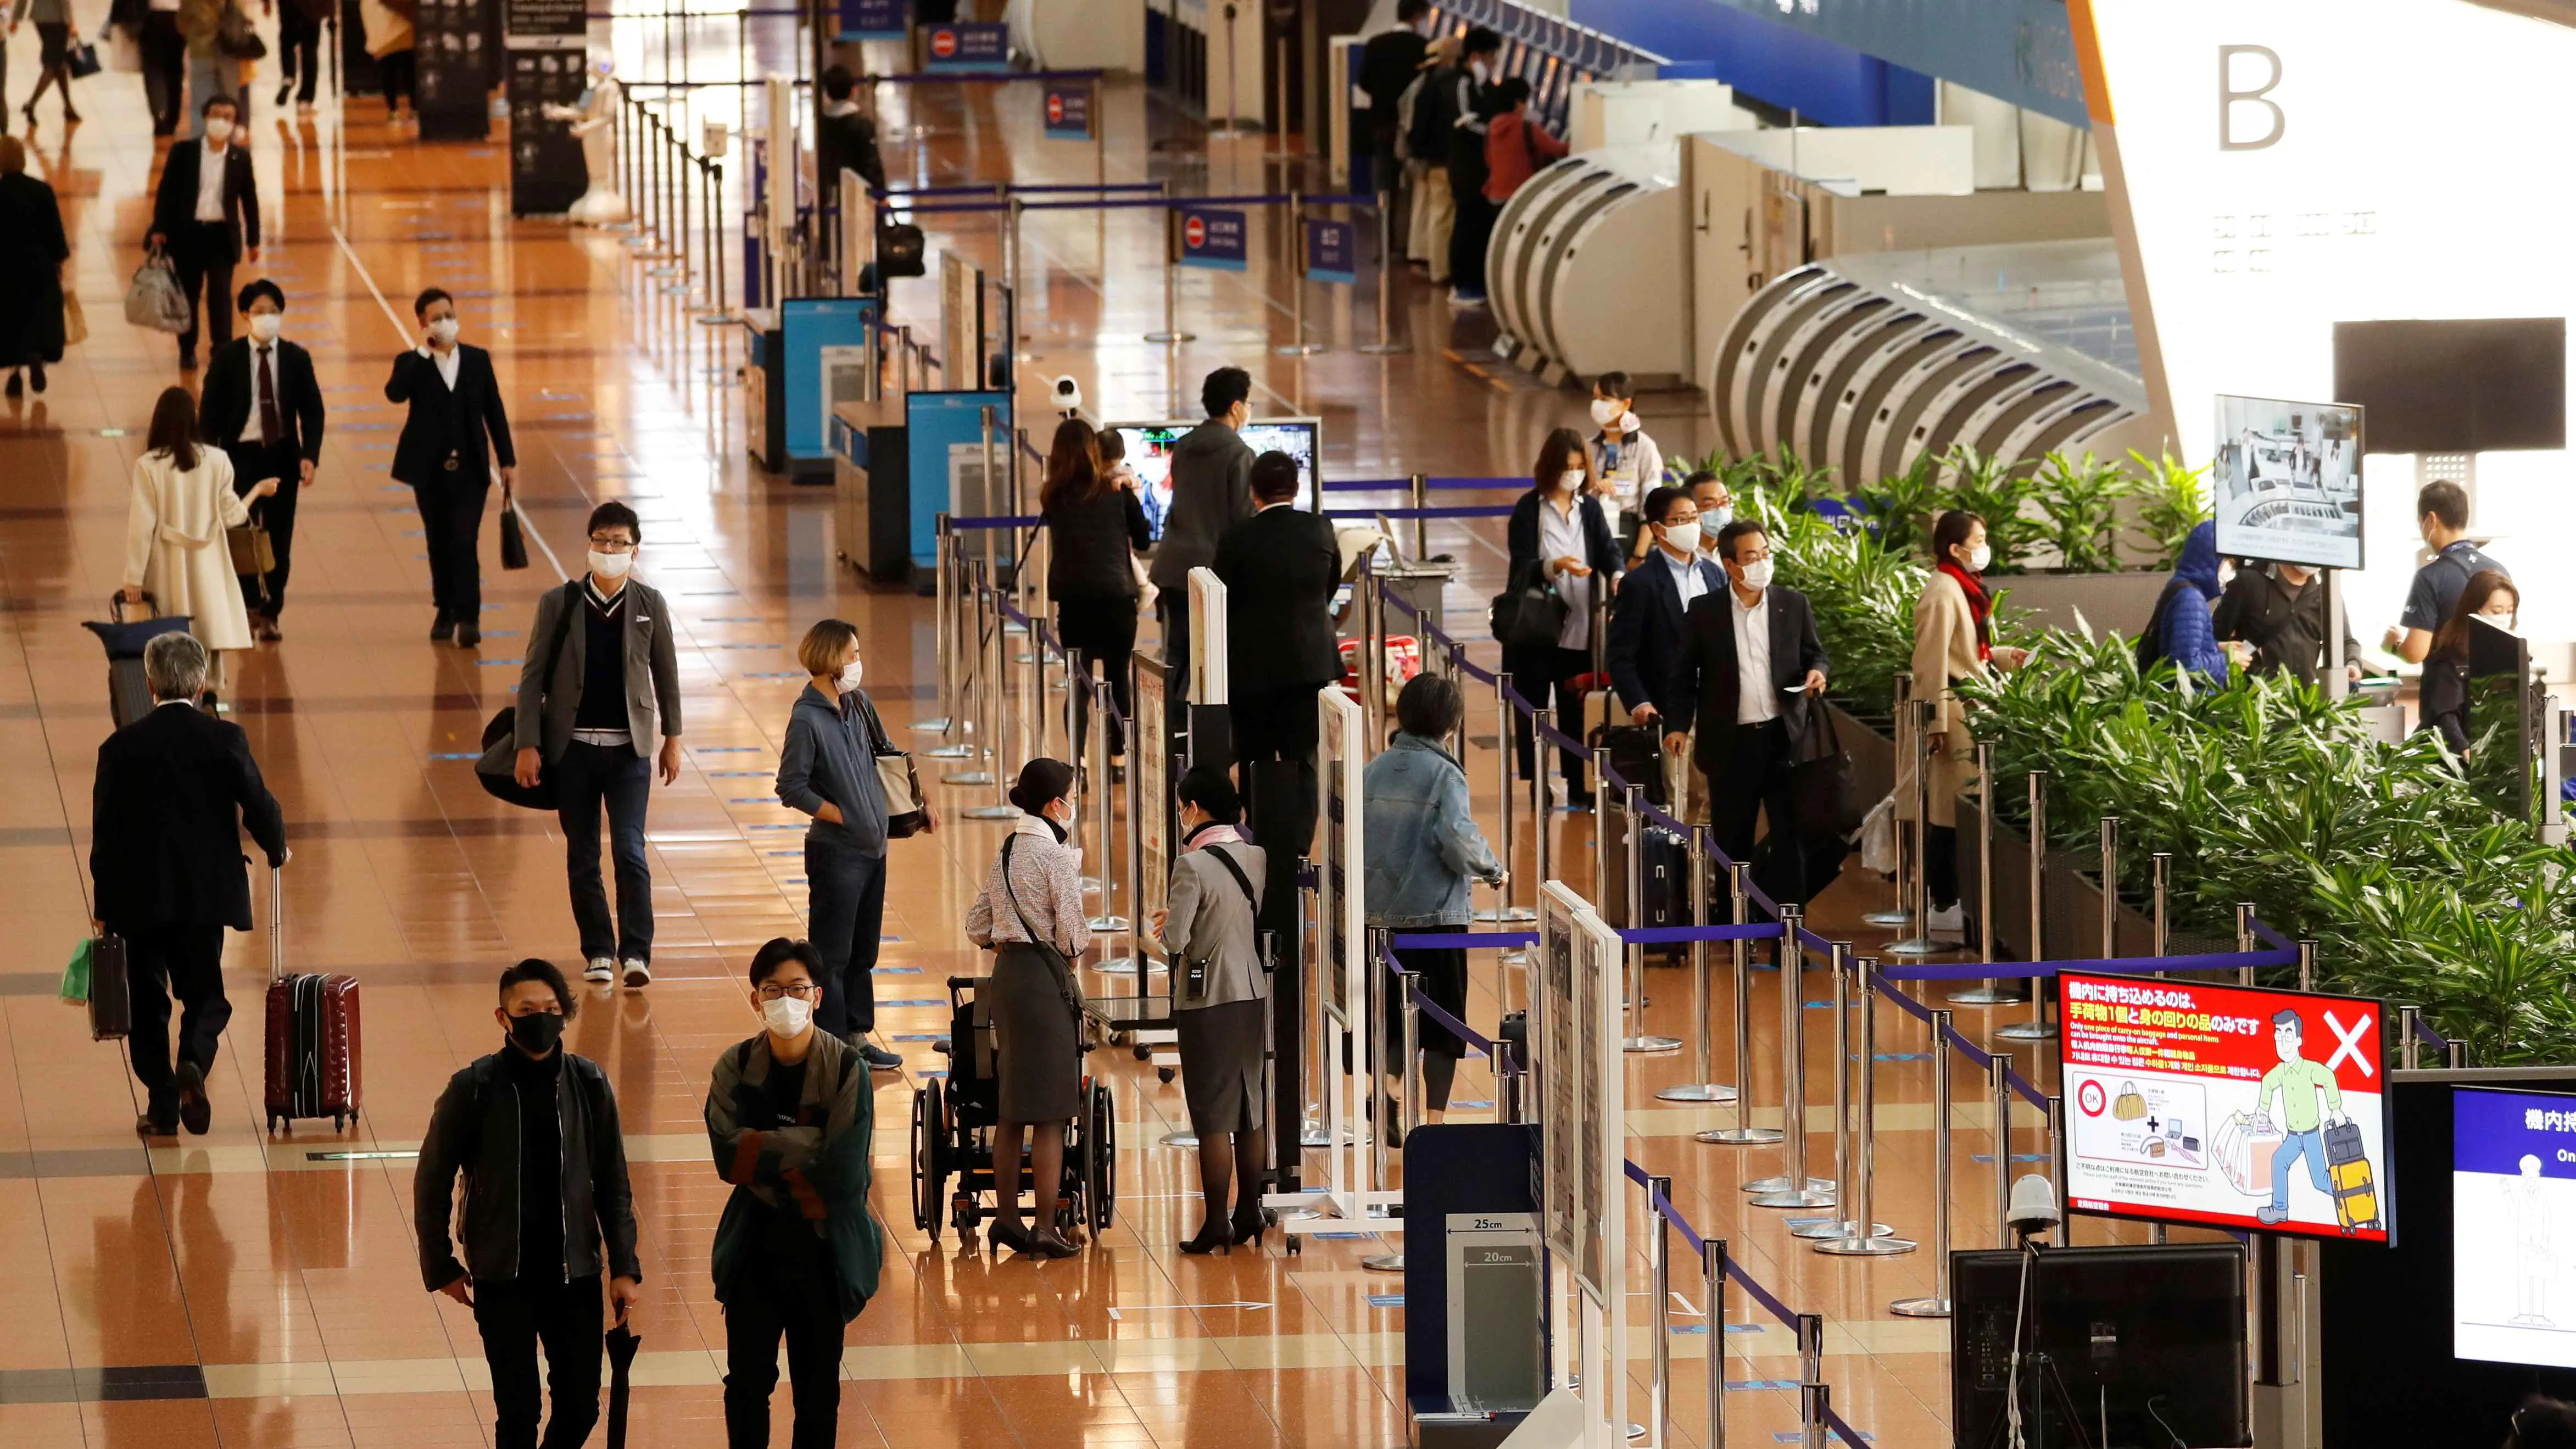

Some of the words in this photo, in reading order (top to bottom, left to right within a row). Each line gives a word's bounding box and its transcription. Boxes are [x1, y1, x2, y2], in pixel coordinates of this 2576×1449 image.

[2218, 44, 2285, 151] B
[2069, 981, 2196, 1009] 機内に持ち込めるのは、
[2070, 1001, 2260, 1035] 手荷物1個と身の回りの品のみです
[2070, 1022, 2083, 1030] Only
[2095, 1024, 2110, 1033] piece
[2118, 1027, 2140, 1035] carry-on
[2142, 1028, 2166, 1039] baggage
[2167, 1031, 2178, 1039] and
[2178, 1033, 2202, 1041] personal
[2203, 1034, 2219, 1043] items
[2089, 1032, 2112, 1042] brought
[2137, 1036, 2159, 1046] aircraft.
[2085, 1093, 2099, 1104] OK
[1474, 1219, 1502, 1229] 25cm
[1484, 1252, 1512, 1262] 20cm
